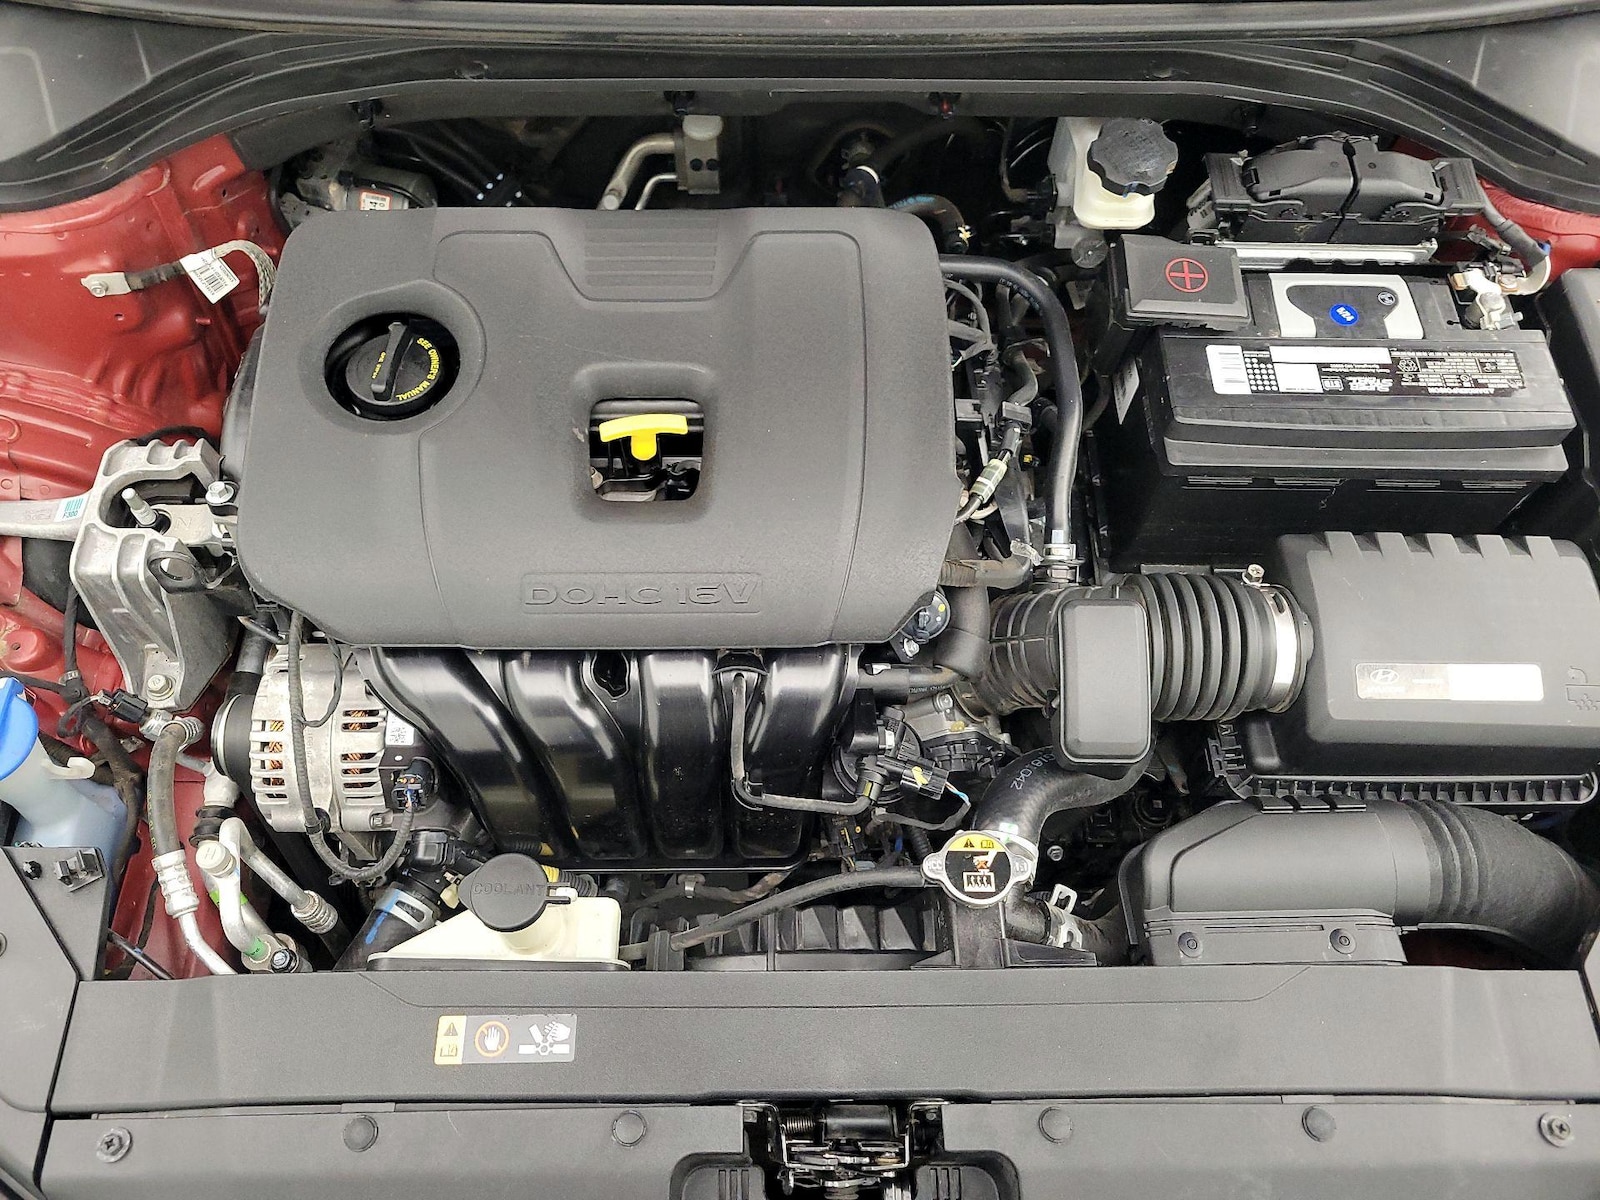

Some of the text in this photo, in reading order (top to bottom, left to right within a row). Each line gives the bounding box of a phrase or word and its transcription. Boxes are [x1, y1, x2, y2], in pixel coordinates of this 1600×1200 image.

[395, 337, 441, 401] SEE OWNER'S MANUAL
[525, 582, 758, 605] DOHC 16V
[474, 882, 546, 897] COOLANT
